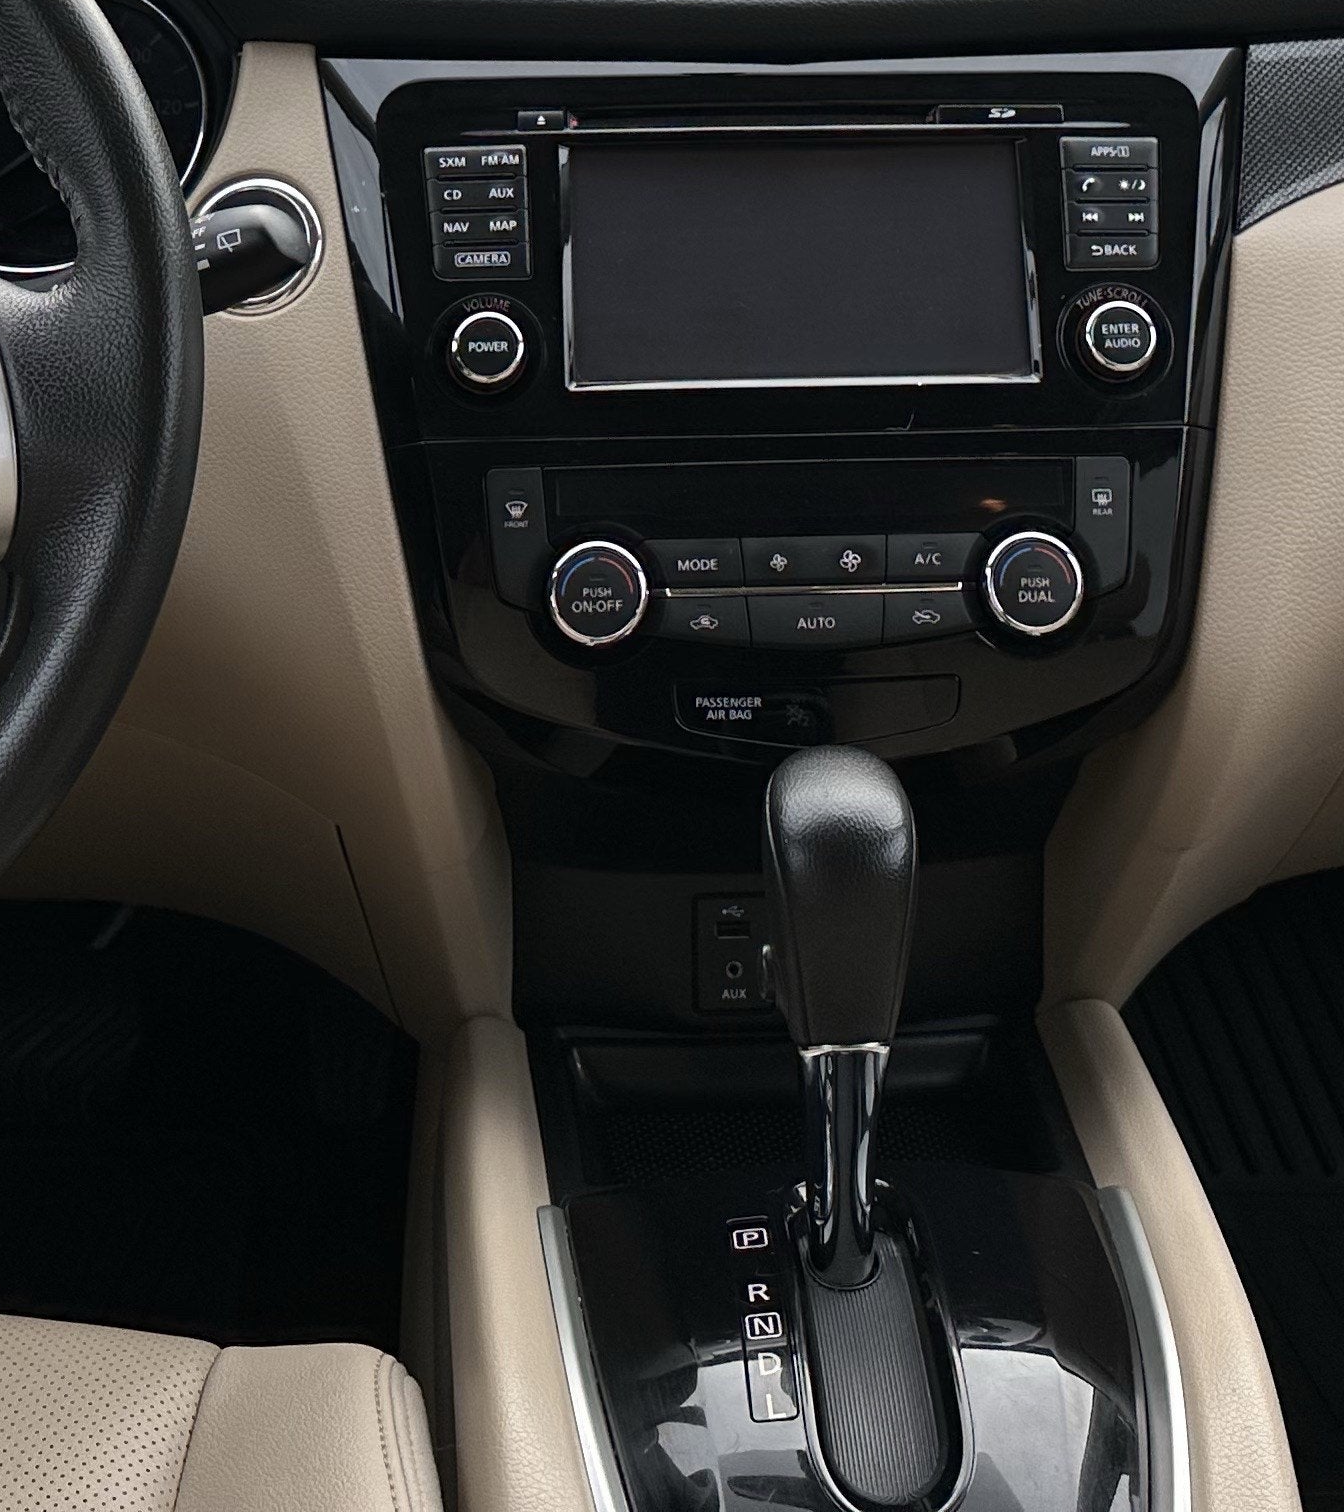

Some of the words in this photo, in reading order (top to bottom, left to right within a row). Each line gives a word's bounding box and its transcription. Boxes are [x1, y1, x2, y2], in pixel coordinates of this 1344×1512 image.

[438, 156, 466, 168] SXM
[443, 190, 463, 201] CD
[488, 188, 515, 199] AUX
[443, 222, 470, 233] NAV
[489, 220, 518, 232] MAP
[1104, 245, 1137, 257] BACK
[457, 253, 508, 265] CAMERA
[462, 298, 511, 313] VOLUME
[1101, 323, 1139, 335] ENTER
[468, 341, 509, 353] POWER
[1104, 337, 1141, 349] AUDIO
[1092, 507, 1113, 517] REAR
[503, 520, 529, 529] FRONT
[914, 551, 942, 566] A/C
[676, 558, 720, 572] MODE
[1020, 576, 1050, 589] PUSH
[582, 587, 612, 598] PUSH
[1018, 589, 1056, 603] DUAL
[796, 616, 836, 630] AUTO
[695, 696, 763, 709] PASSENGER
[706, 709, 726, 721] AIR
[728, 709, 752, 721] BAG
[721, 988, 747, 1000] AUX
[747, 1283, 771, 1303] R
[753, 1316, 775, 1336] N
[757, 1352, 783, 1376] D
[765, 1393, 787, 1420] L
